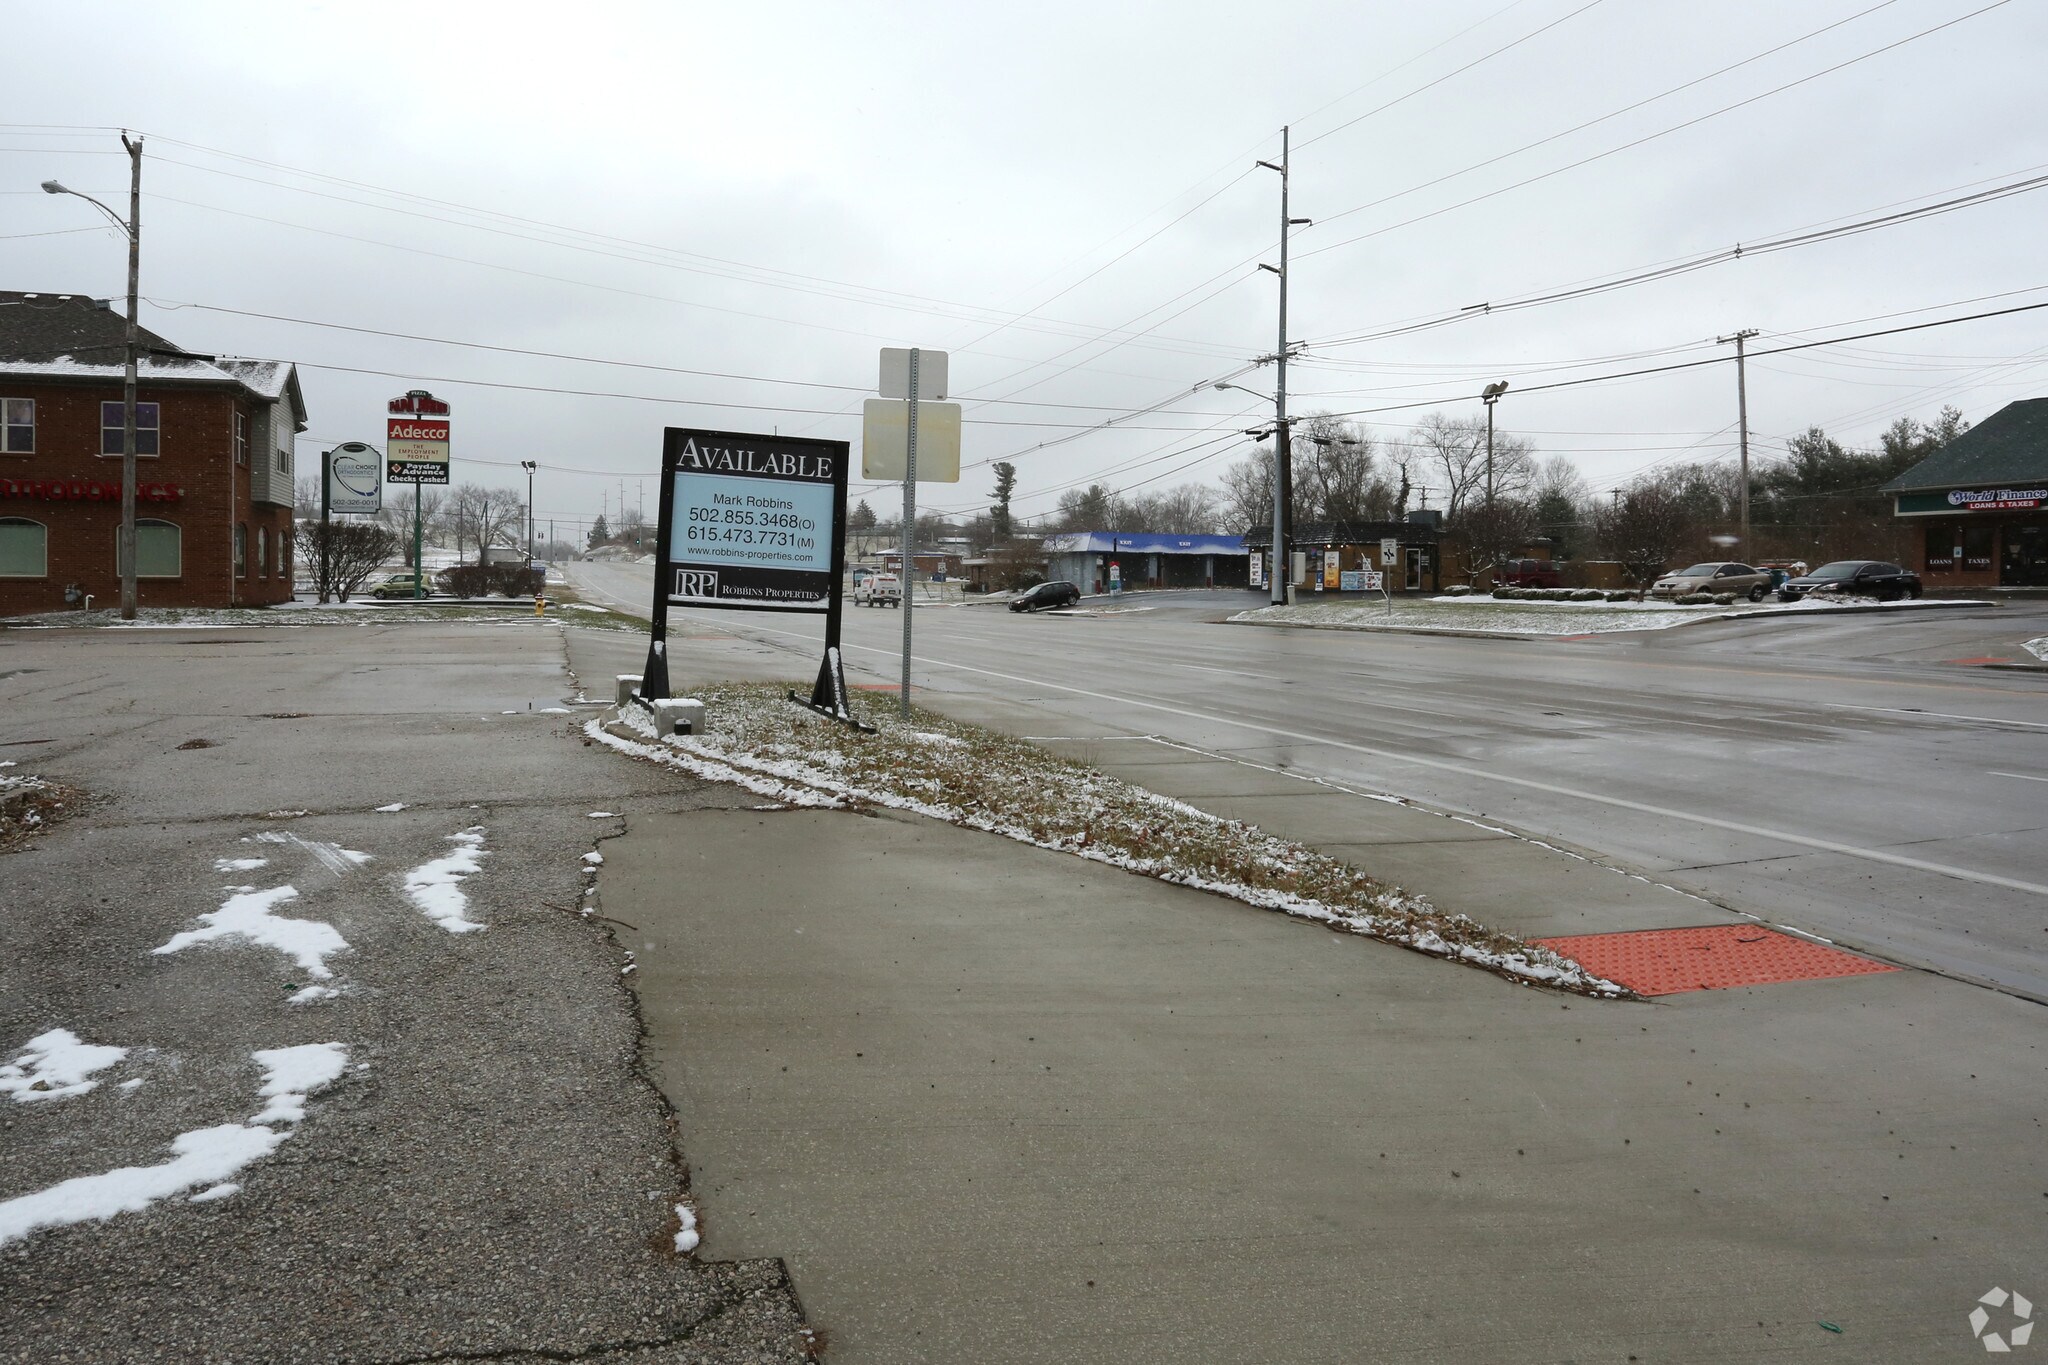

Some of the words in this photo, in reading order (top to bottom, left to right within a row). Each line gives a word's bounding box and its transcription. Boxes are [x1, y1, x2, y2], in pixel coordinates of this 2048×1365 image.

[390, 424, 448, 439] Adecco
[676, 437, 833, 479] AVAILABLE
[406, 463, 441, 471] Payday
[0, 479, 179, 501] RTHODONICS
[1960, 490, 1995, 502] World
[1997, 489, 2048, 500] Finance
[713, 493, 743, 506] Mark
[746, 496, 793, 510] Robbins
[687, 546, 813, 562] www.robbins-properties.com
[679, 572, 715, 597] RP
[722, 584, 763, 596] ROBBINS
[765, 587, 819, 599] PROPERTIES
